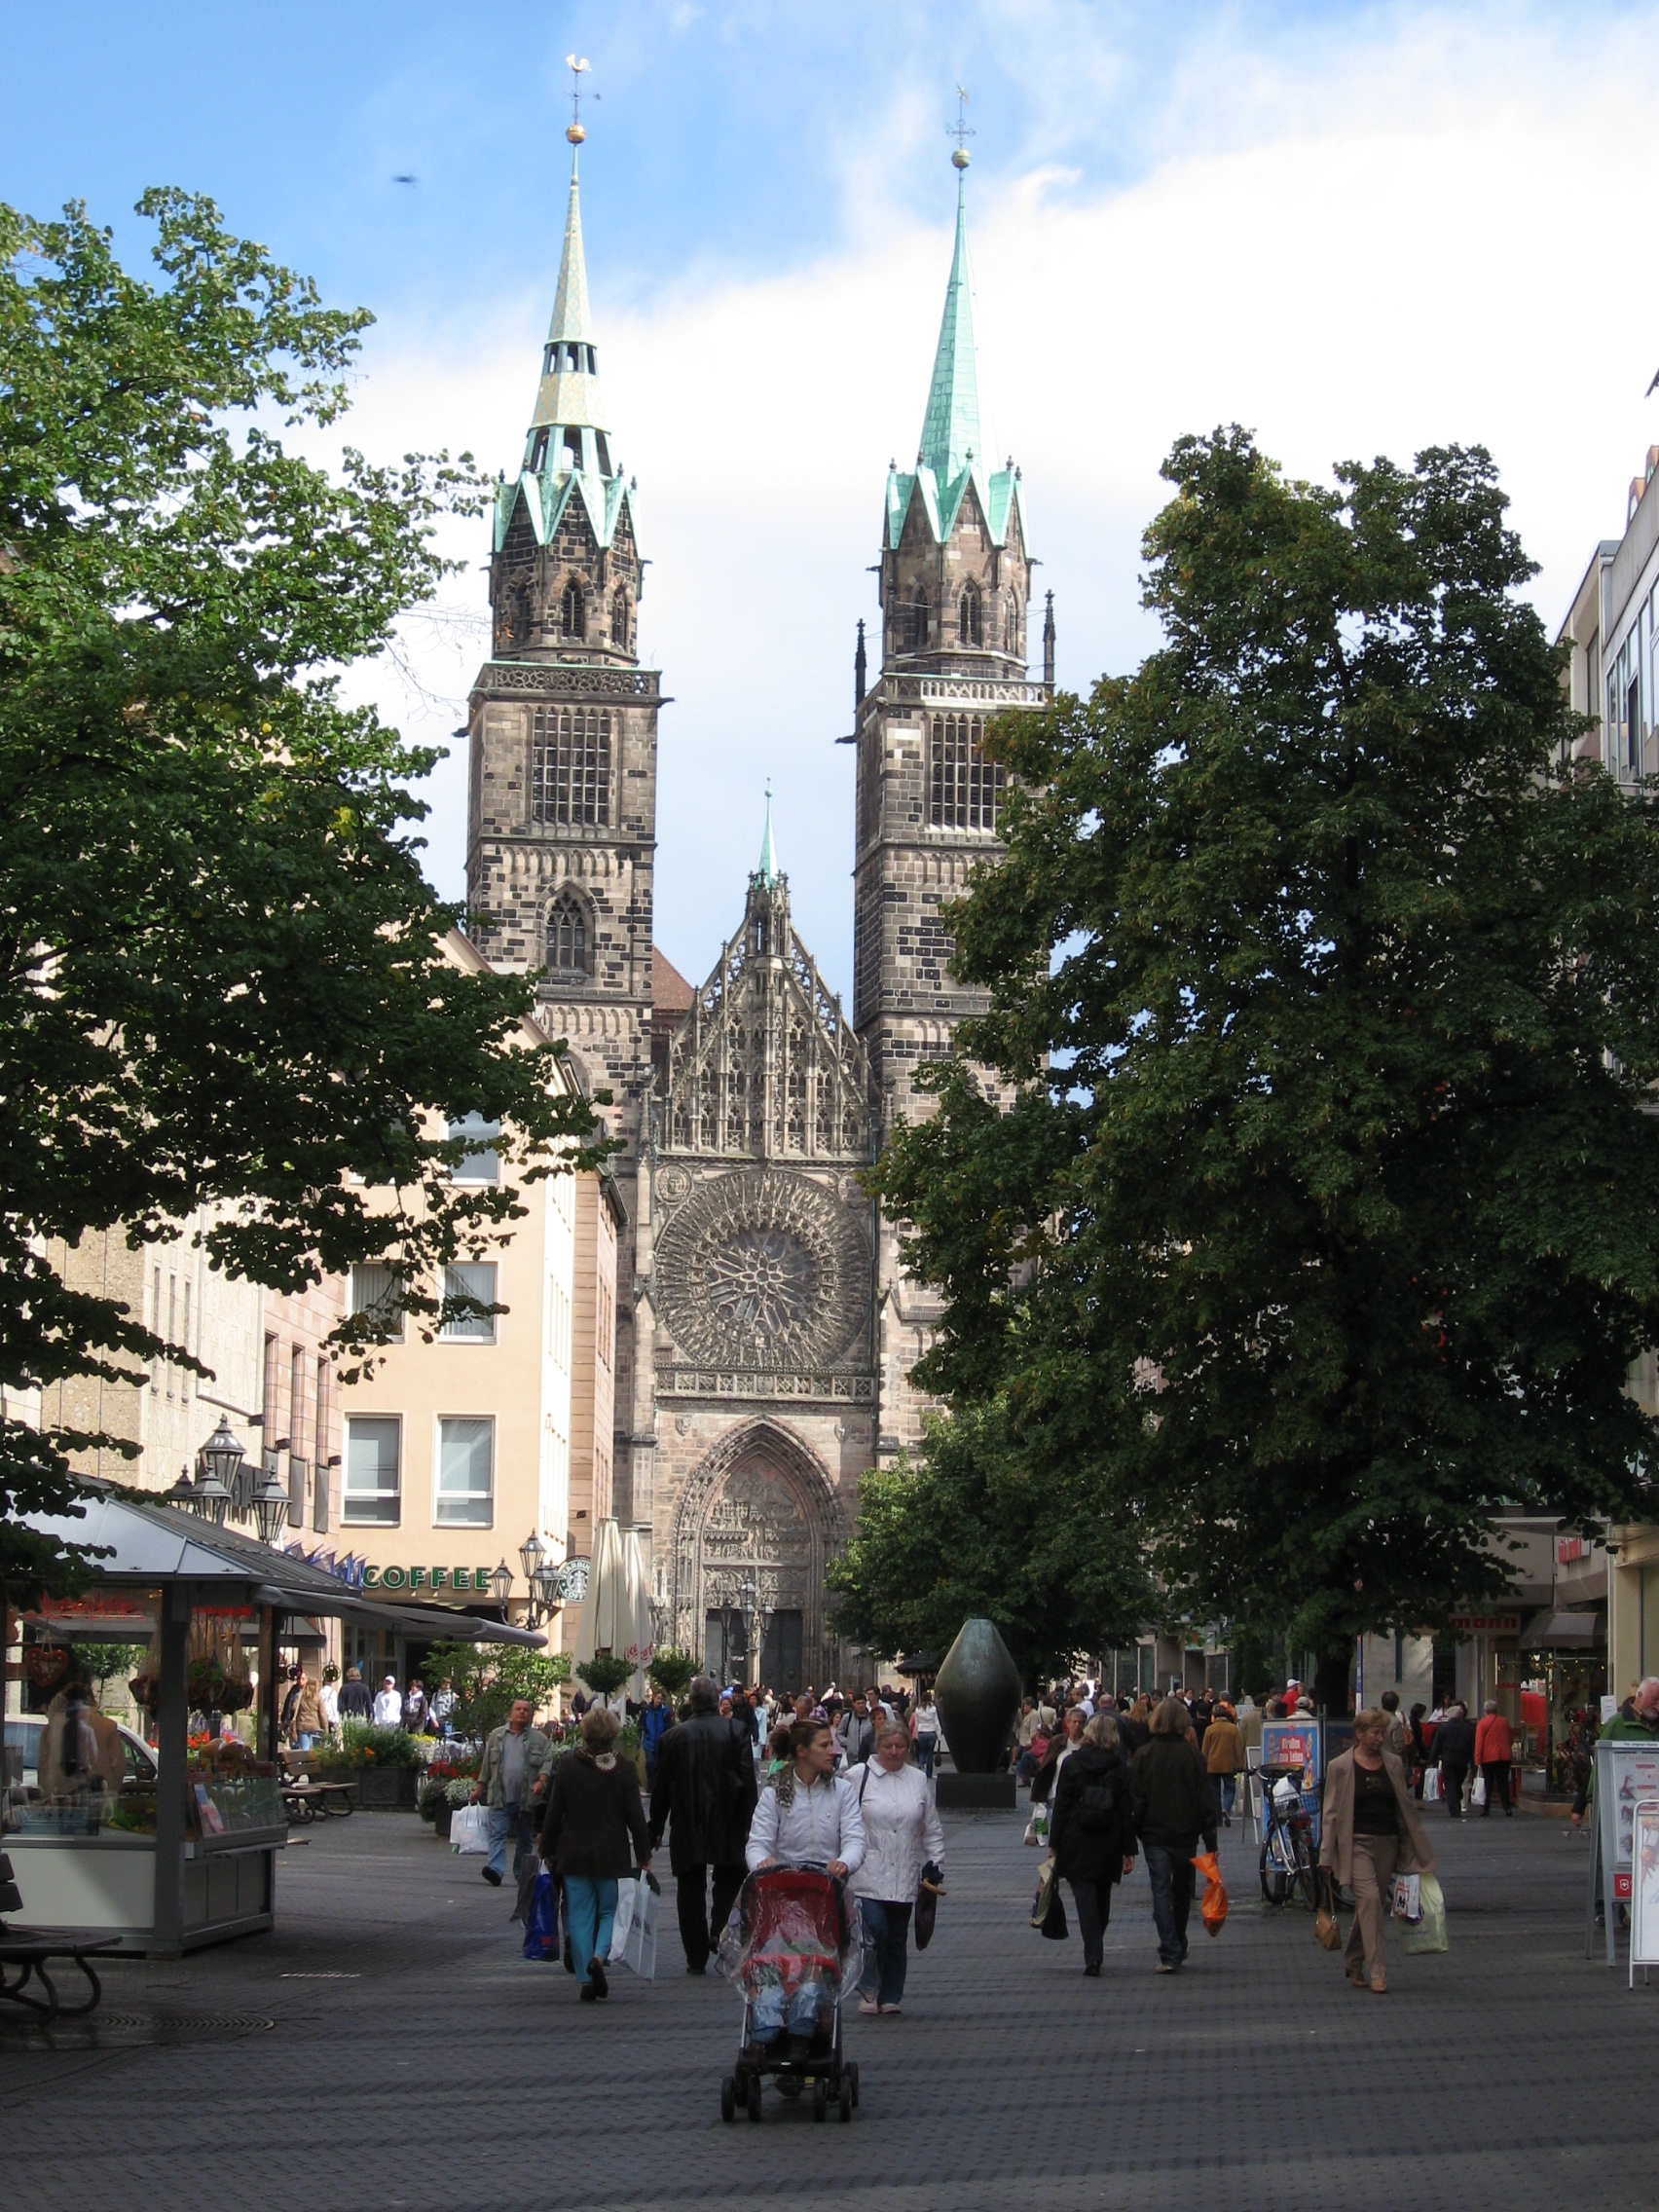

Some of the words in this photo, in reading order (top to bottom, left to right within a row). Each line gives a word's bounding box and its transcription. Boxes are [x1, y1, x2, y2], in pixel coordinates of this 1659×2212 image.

[362, 1565, 493, 1590] COFFEE
[561, 1561, 591, 1579] STARBUC
[565, 1588, 586, 1600] COFF
